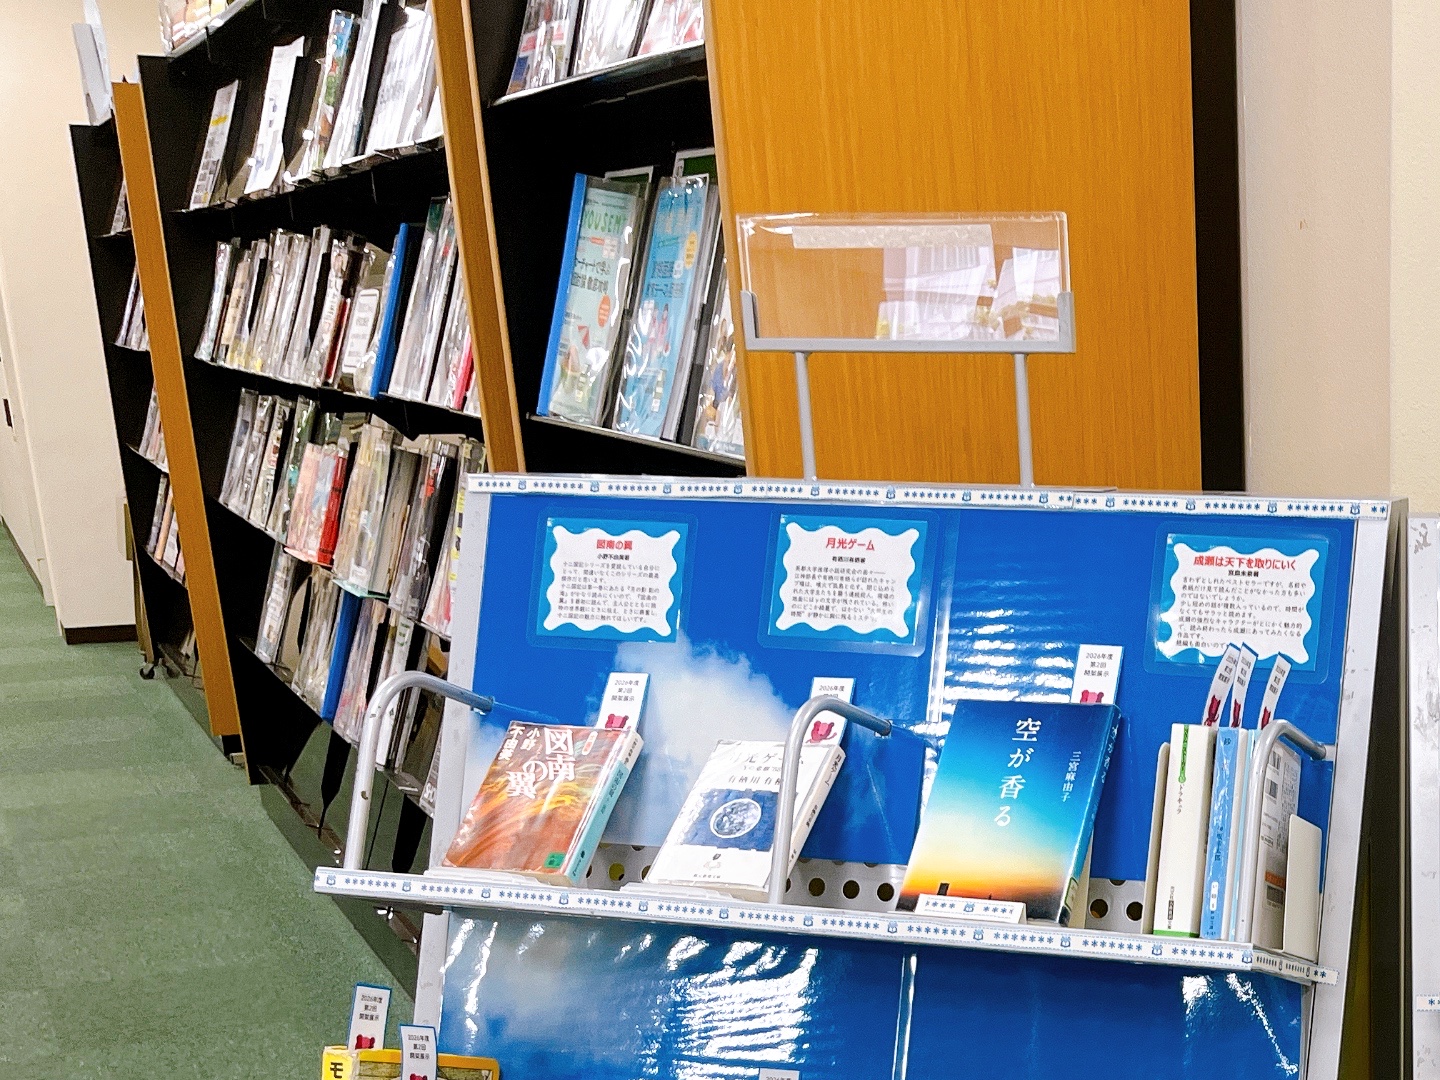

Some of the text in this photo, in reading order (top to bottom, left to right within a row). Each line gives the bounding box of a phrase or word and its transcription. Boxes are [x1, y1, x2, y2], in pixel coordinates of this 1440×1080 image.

[826, 538, 874, 551] 月光ゲーム
[1193, 556, 1297, 571] 成瀬は天下を取りにいく
[506, 727, 576, 799] 図南の翼
[993, 717, 1042, 828] 空が香る
